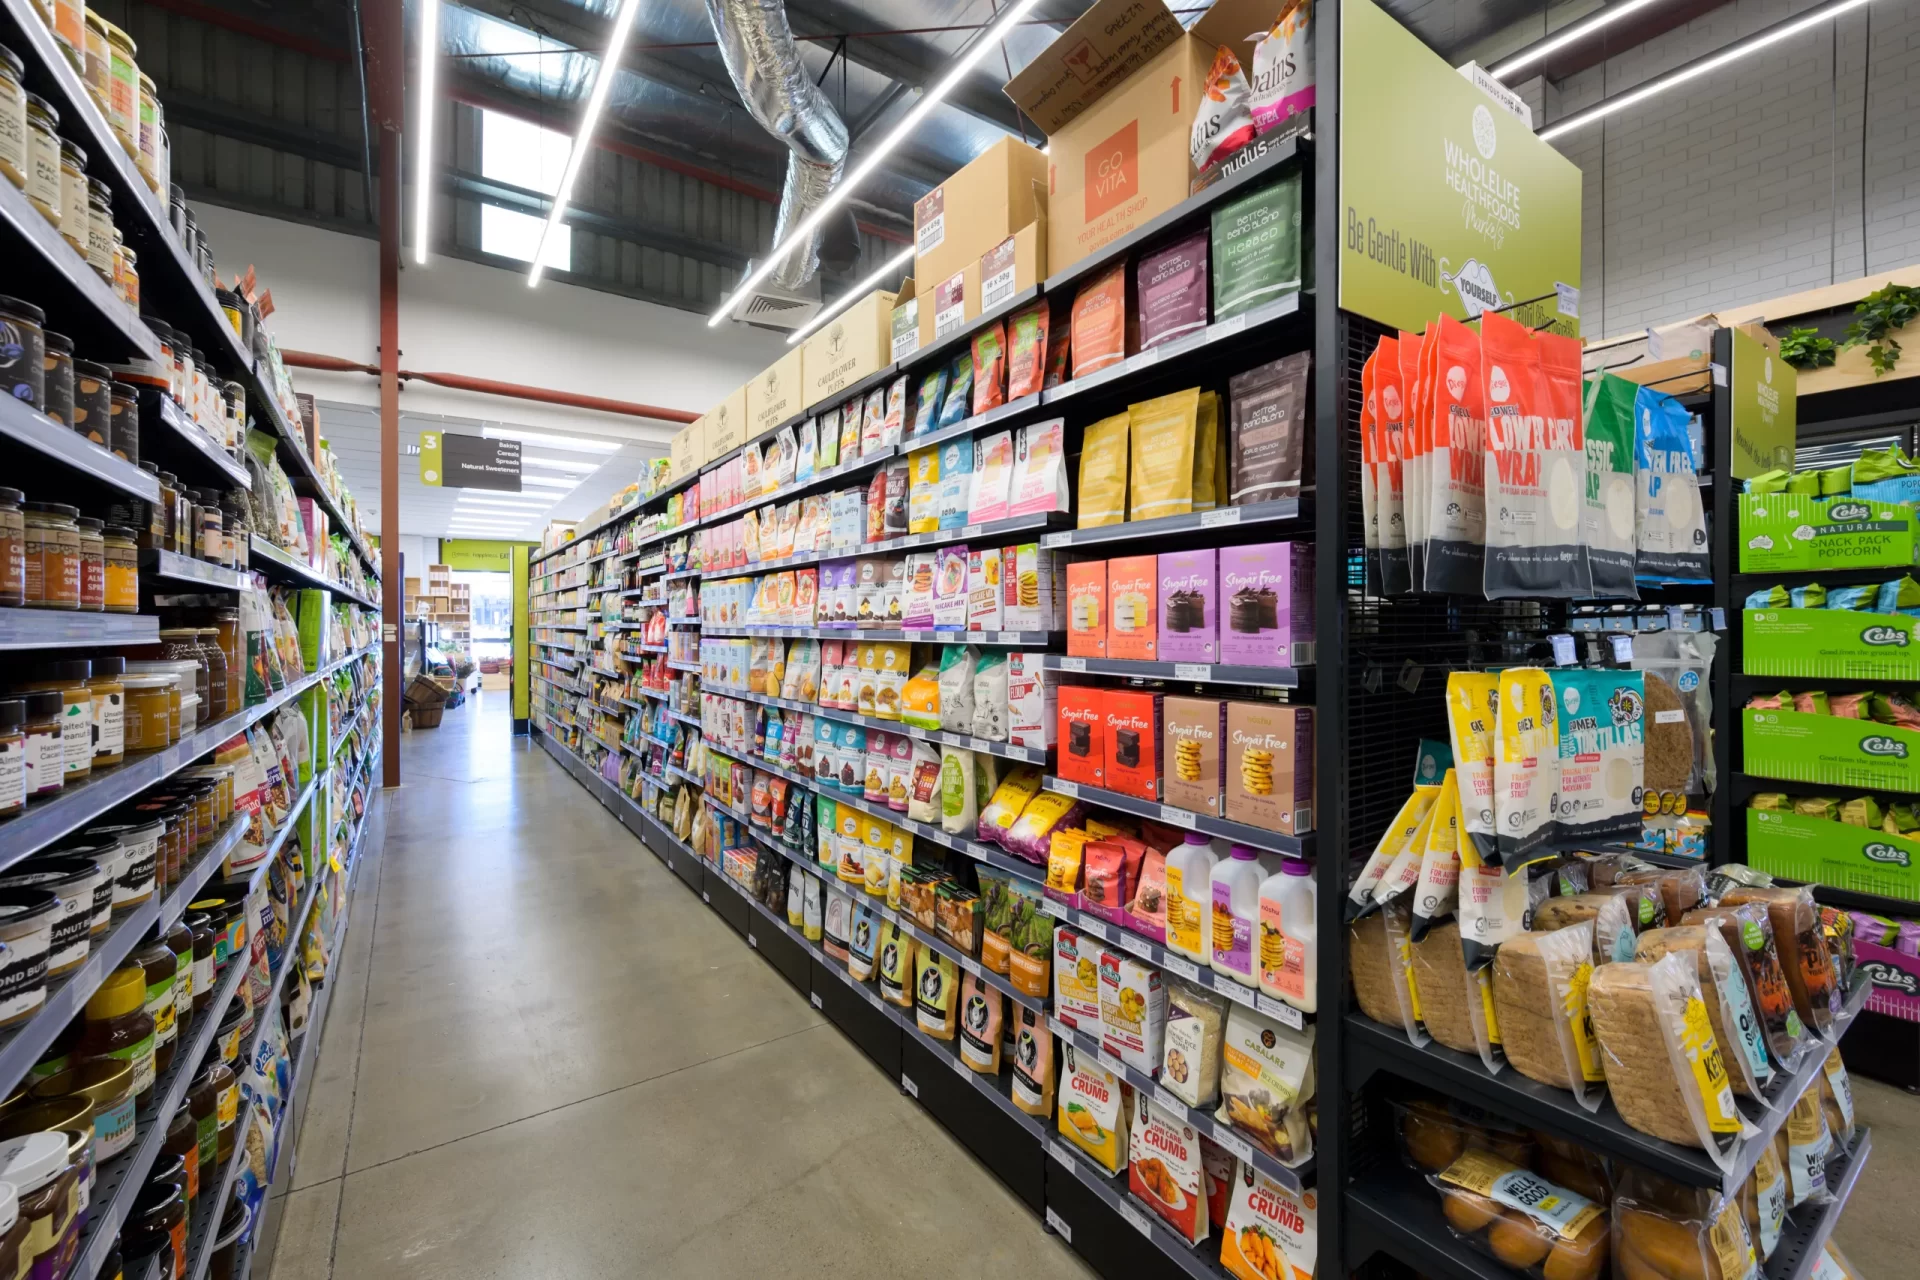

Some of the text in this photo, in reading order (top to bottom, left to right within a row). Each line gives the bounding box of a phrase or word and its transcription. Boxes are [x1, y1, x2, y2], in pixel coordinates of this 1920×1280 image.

[1098, 151, 1123, 178] GO
[1221, 140, 1268, 179] nudus
[1444, 137, 1520, 210] WHOLELIFE
[1095, 169, 1127, 199] VITA
[1445, 167, 1520, 230] HEALTHFOODS
[1077, 196, 1148, 245] YOUR HEALTH SHOP
[1347, 206, 1436, 289] Be Gentle With
[1460, 277, 1497, 307] YOURSELF
[818, 357, 856, 387] CAULIFLOWER
[827, 378, 845, 394] PUFFS
[424, 435, 437, 449] 3
[499, 442, 519, 451] Baking
[495, 458, 520, 466] Spreads
[497, 450, 519, 458] Cereals
[461, 462, 520, 474] Natural Sweeteners
[1831, 503, 1869, 519] Cobs
[1820, 523, 1882, 534] NATURAL
[1809, 535, 1892, 549] SNACK PACK
[1818, 546, 1882, 558] POPCORN
[1111, 578, 1151, 594] Sugar Free
[1162, 574, 1209, 591] Sugar Free
[1225, 570, 1283, 590] Sugar Free
[1069, 582, 1102, 596] Sugar Free
[1863, 627, 1907, 645] Cobs
[1010, 686, 1025, 699] FLOUR
[1061, 706, 1098, 723] Sugar Free
[1107, 713, 1148, 730] Sugar Free
[64, 722, 85, 732] alted
[1167, 721, 1213, 741] Sugar Free
[1576, 716, 1598, 731] MEX
[64, 731, 86, 741] eanut
[1232, 729, 1288, 752] Sugar Free
[1575, 722, 1642, 755] TORTILLAS
[1862, 736, 1904, 756] Cobs
[1819, 754, 1837, 762] Good
[1838, 755, 1855, 763] from
[1856, 756, 1868, 764] the
[1869, 759, 1896, 768] ground
[1562, 776, 1572, 785] FOR
[1865, 843, 1908, 865] Cobs
[132, 862, 156, 875] PEANU
[1430, 869, 1442, 877] FOR
[1088, 902, 1113, 917] Sugar Free
[1185, 911, 1198, 922] Free
[1135, 920, 1157, 933] Sugar Free
[1229, 918, 1251, 933] Sugar
[1233, 930, 1248, 942] Free
[1280, 938, 1303, 954] Sugar
[1284, 950, 1301, 964] Free
[1244, 1039, 1286, 1069] CASALARE
[1077, 1070, 1105, 1088] LOW CARB
[1071, 1076, 1109, 1103] CRUMB
[1151, 1123, 1183, 1145] LOW CARB
[1144, 1129, 1188, 1162] CRUMB
[1257, 1186, 1298, 1214] LOW CARB
[1518, 1185, 1550, 1206] GOOD
[1248, 1193, 1305, 1234] CRUMB
